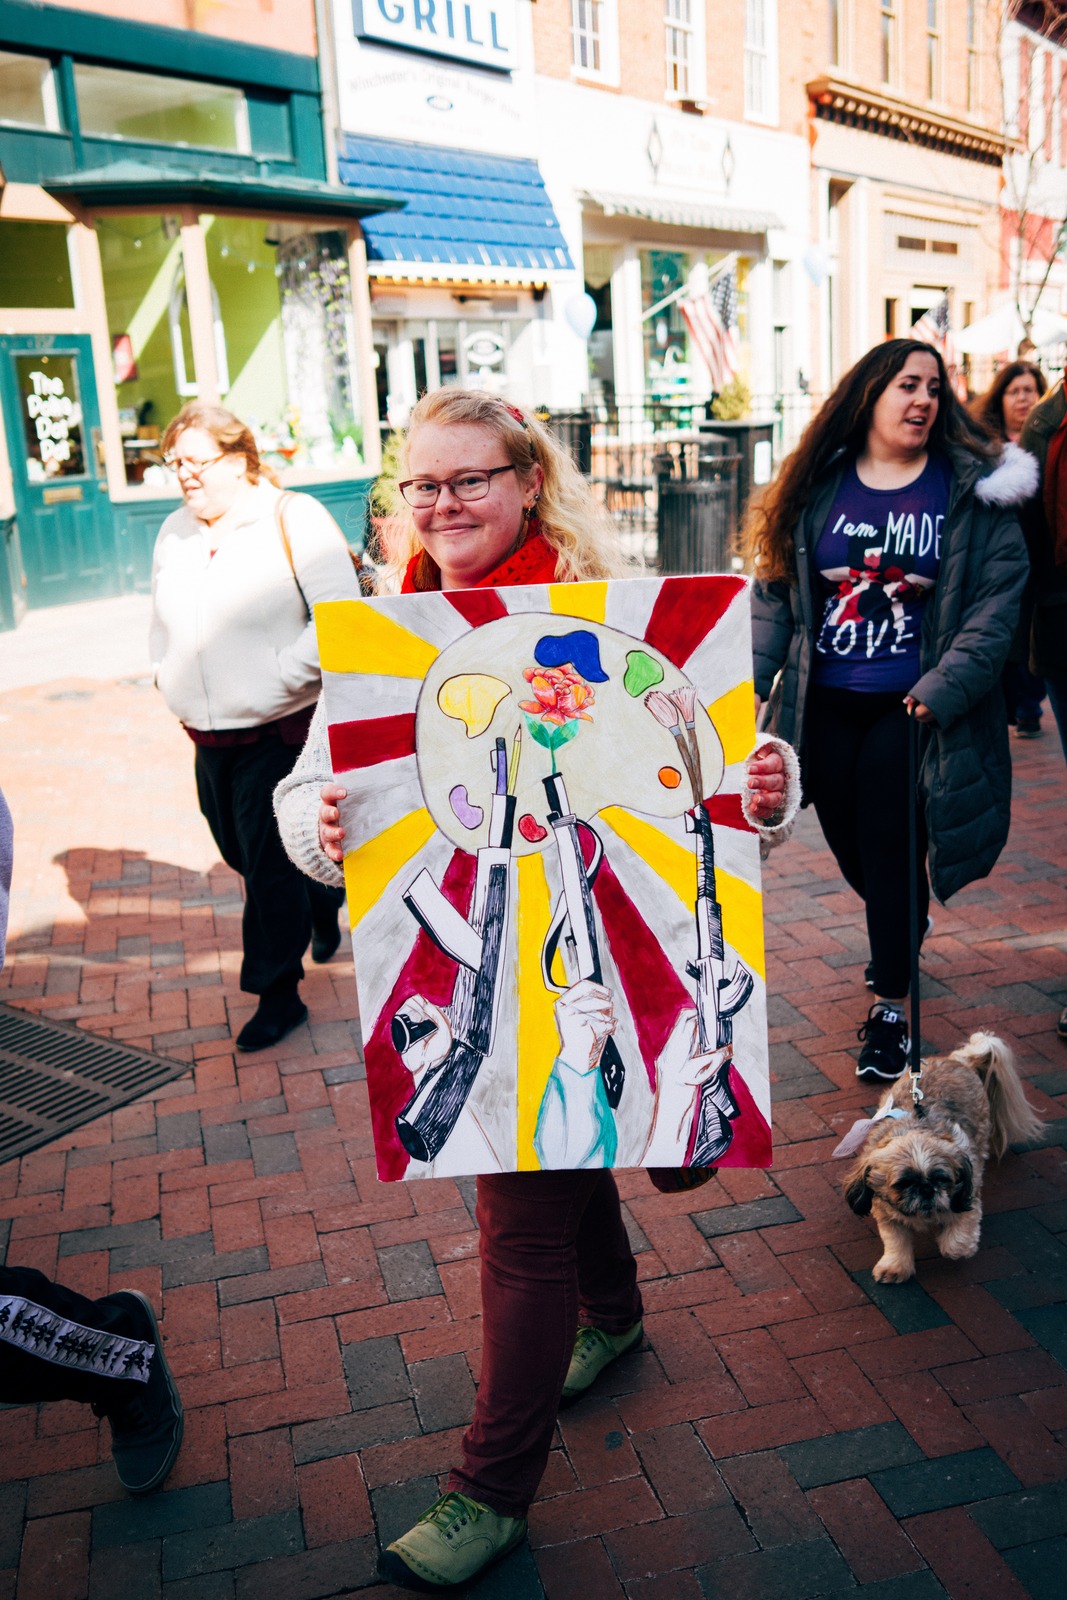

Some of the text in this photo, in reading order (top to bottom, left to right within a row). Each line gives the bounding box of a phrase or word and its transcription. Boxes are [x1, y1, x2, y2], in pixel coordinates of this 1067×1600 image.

[376, 0, 509, 52] GRILL
[29, 371, 64, 396] The
[832, 511, 945, 560] I am MADE
